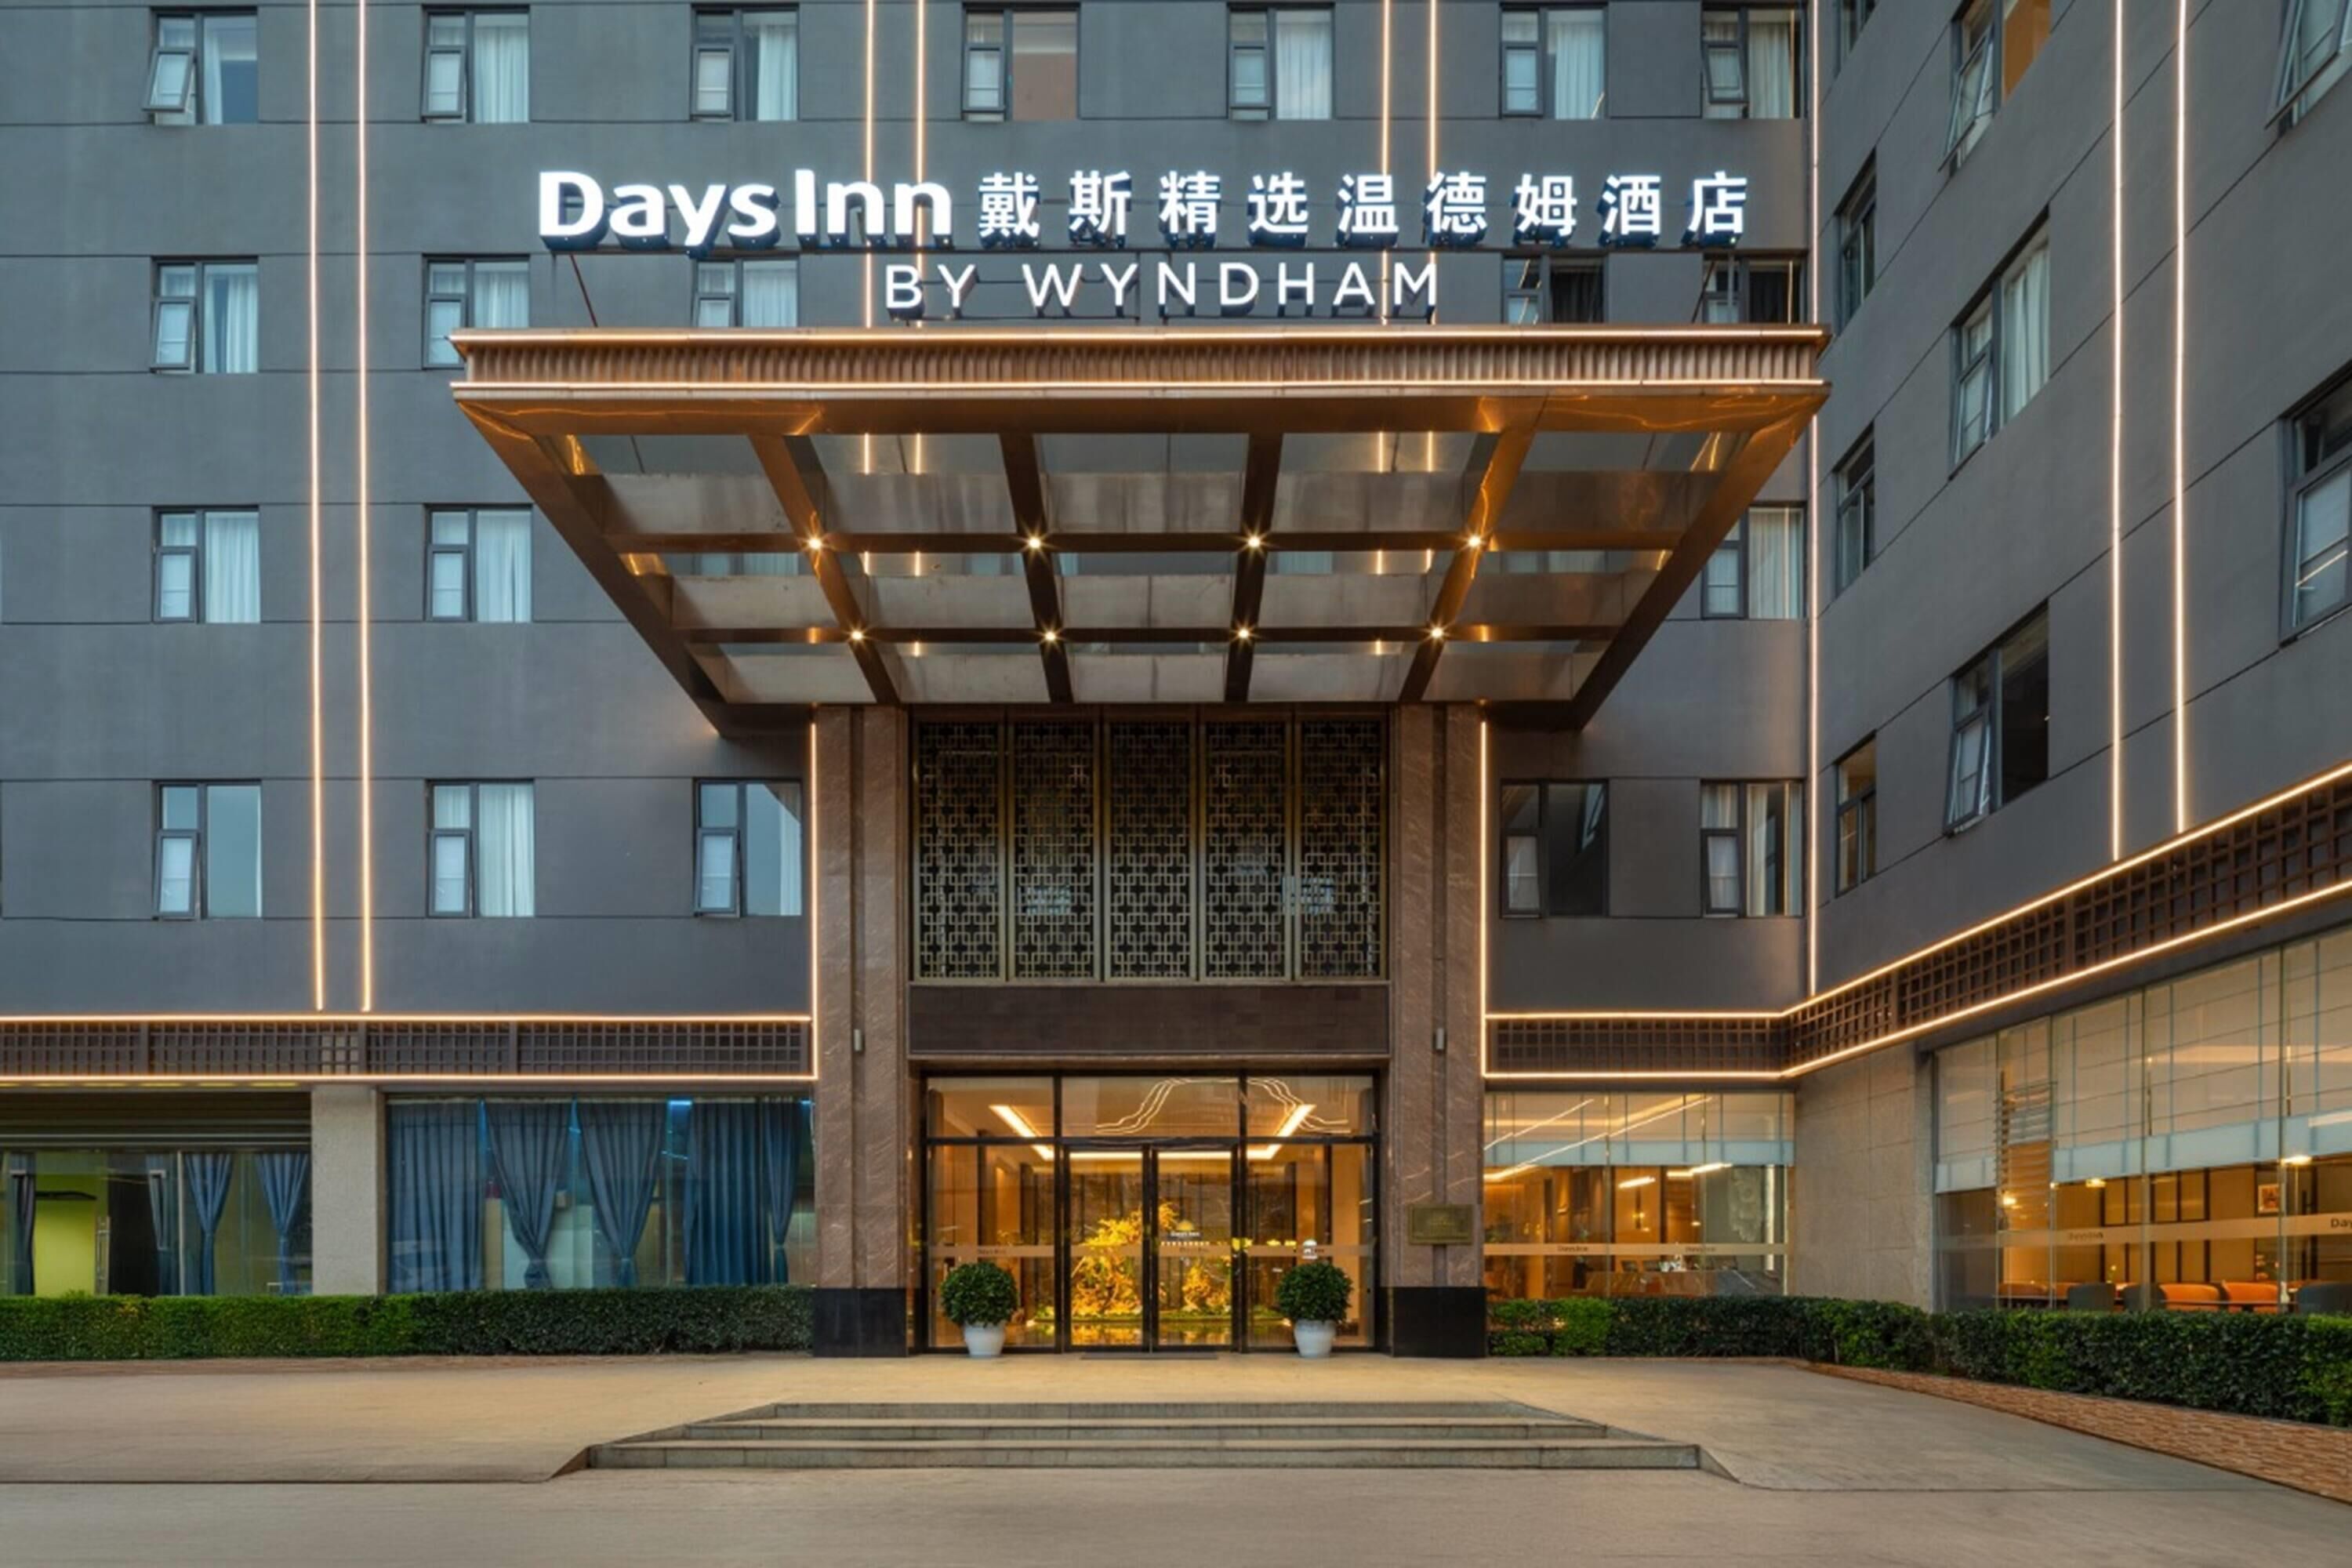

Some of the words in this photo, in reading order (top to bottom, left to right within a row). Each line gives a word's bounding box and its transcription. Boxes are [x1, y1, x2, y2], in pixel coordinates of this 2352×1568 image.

[539, 171, 777, 246] Days
[795, 169, 952, 235] Inn
[978, 170, 1748, 238] 戴斯精选温德姆酒店
[885, 264, 975, 309] BY
[1022, 263, 1437, 308] WYNDHAM
